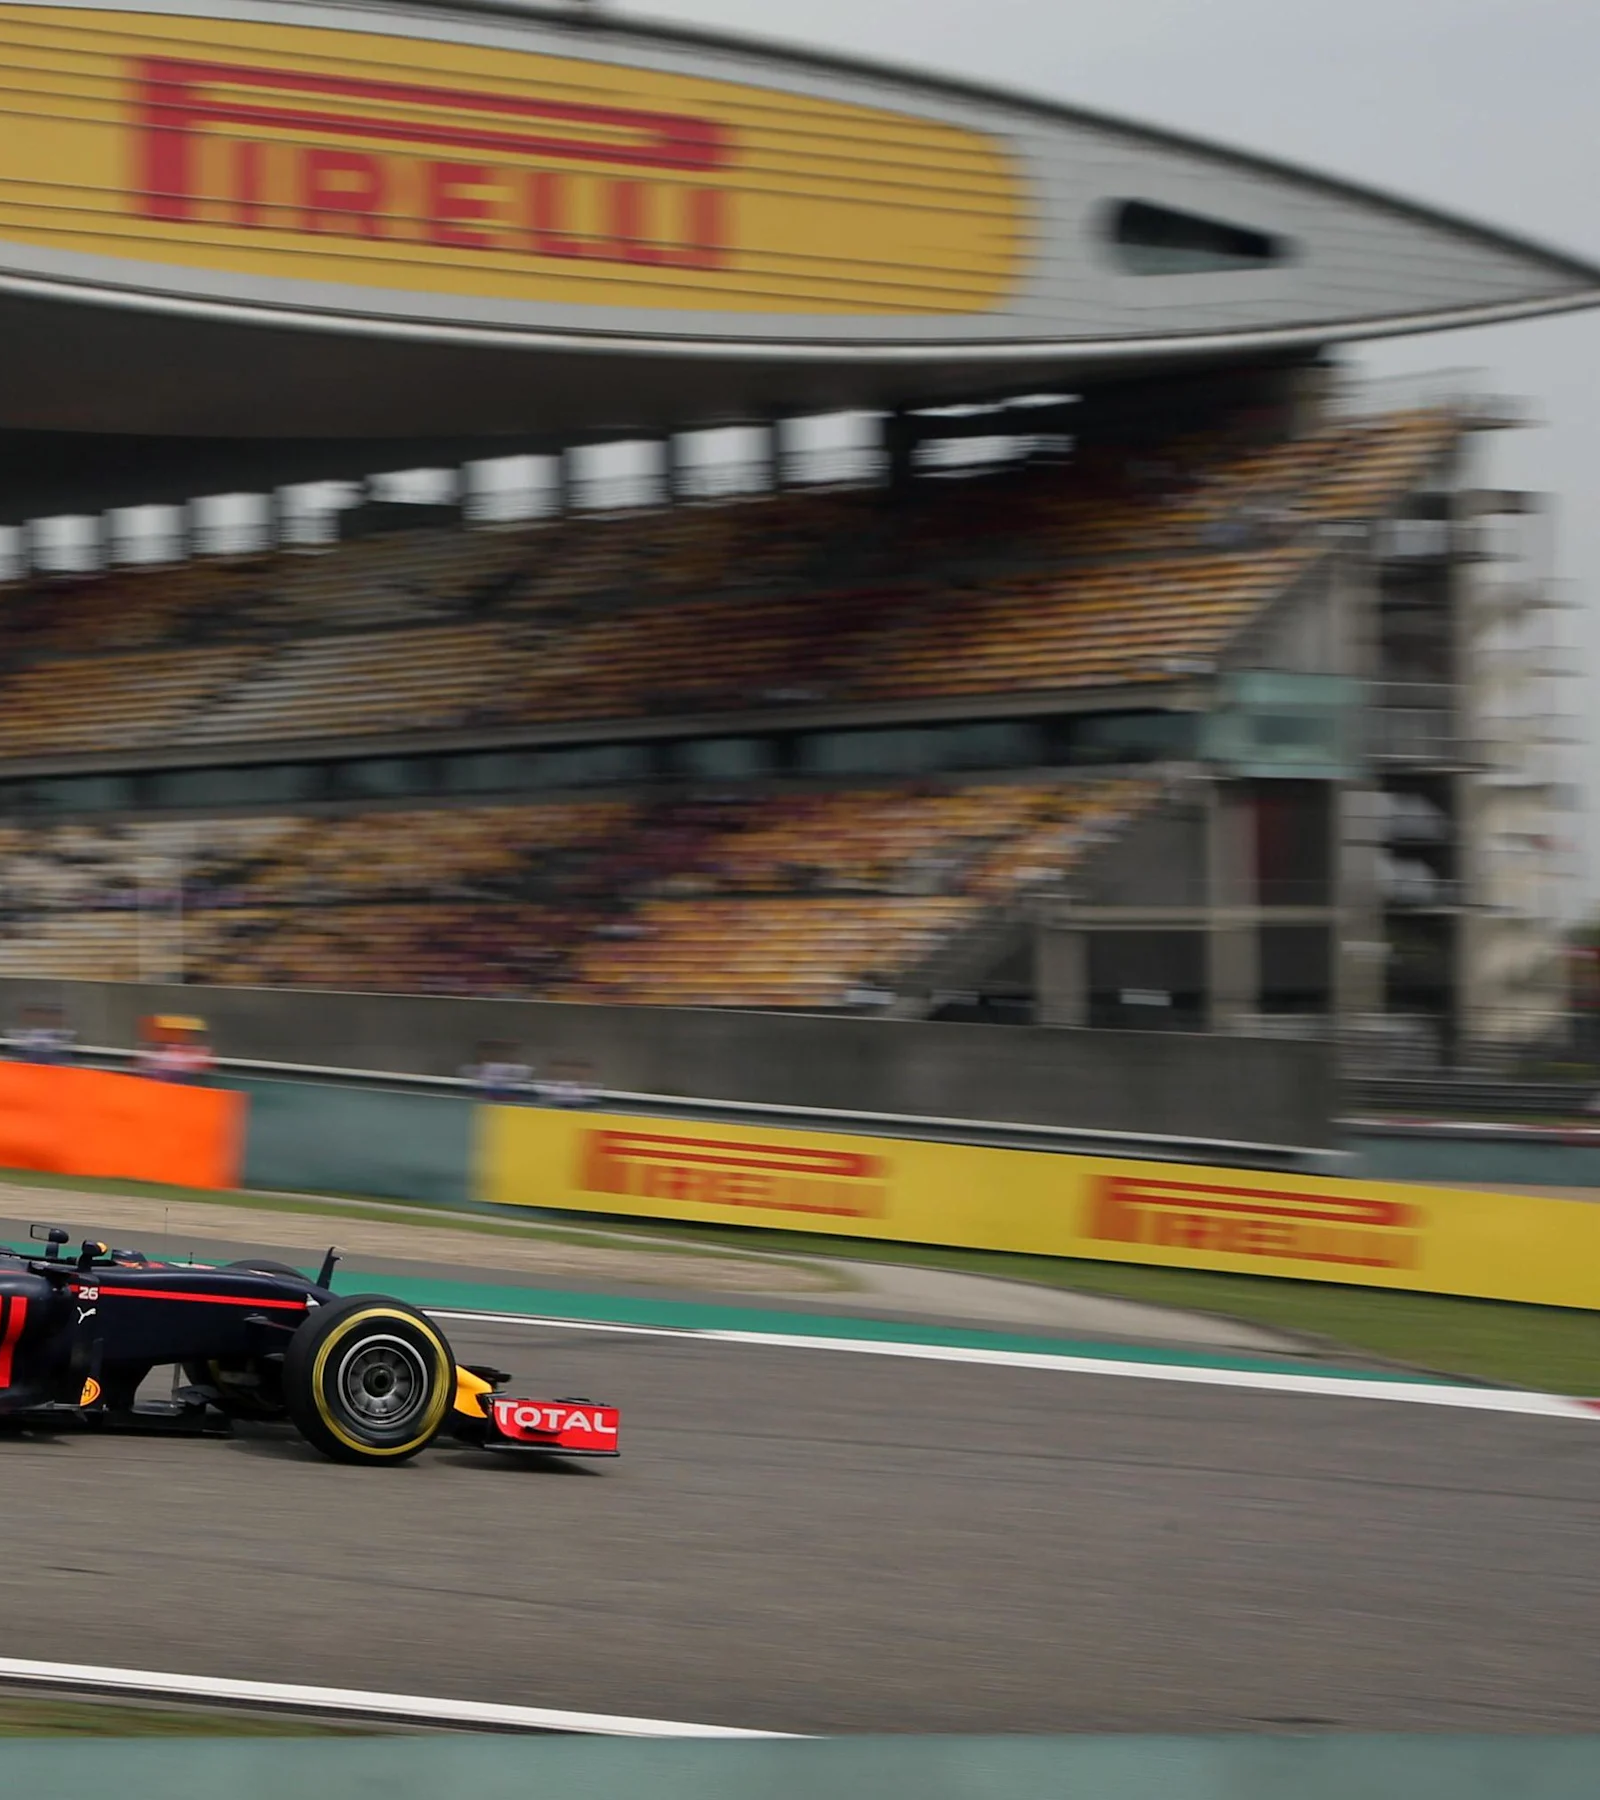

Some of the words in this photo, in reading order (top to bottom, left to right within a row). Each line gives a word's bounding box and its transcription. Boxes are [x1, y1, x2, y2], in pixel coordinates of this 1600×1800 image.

[135, 54, 738, 270] PIRELLI
[576, 1129, 890, 1219] PIRELLI
[1080, 1174, 1424, 1270] PIRELLI
[78, 1286, 99, 1300] 26
[494, 1400, 617, 1434] TOTAL
